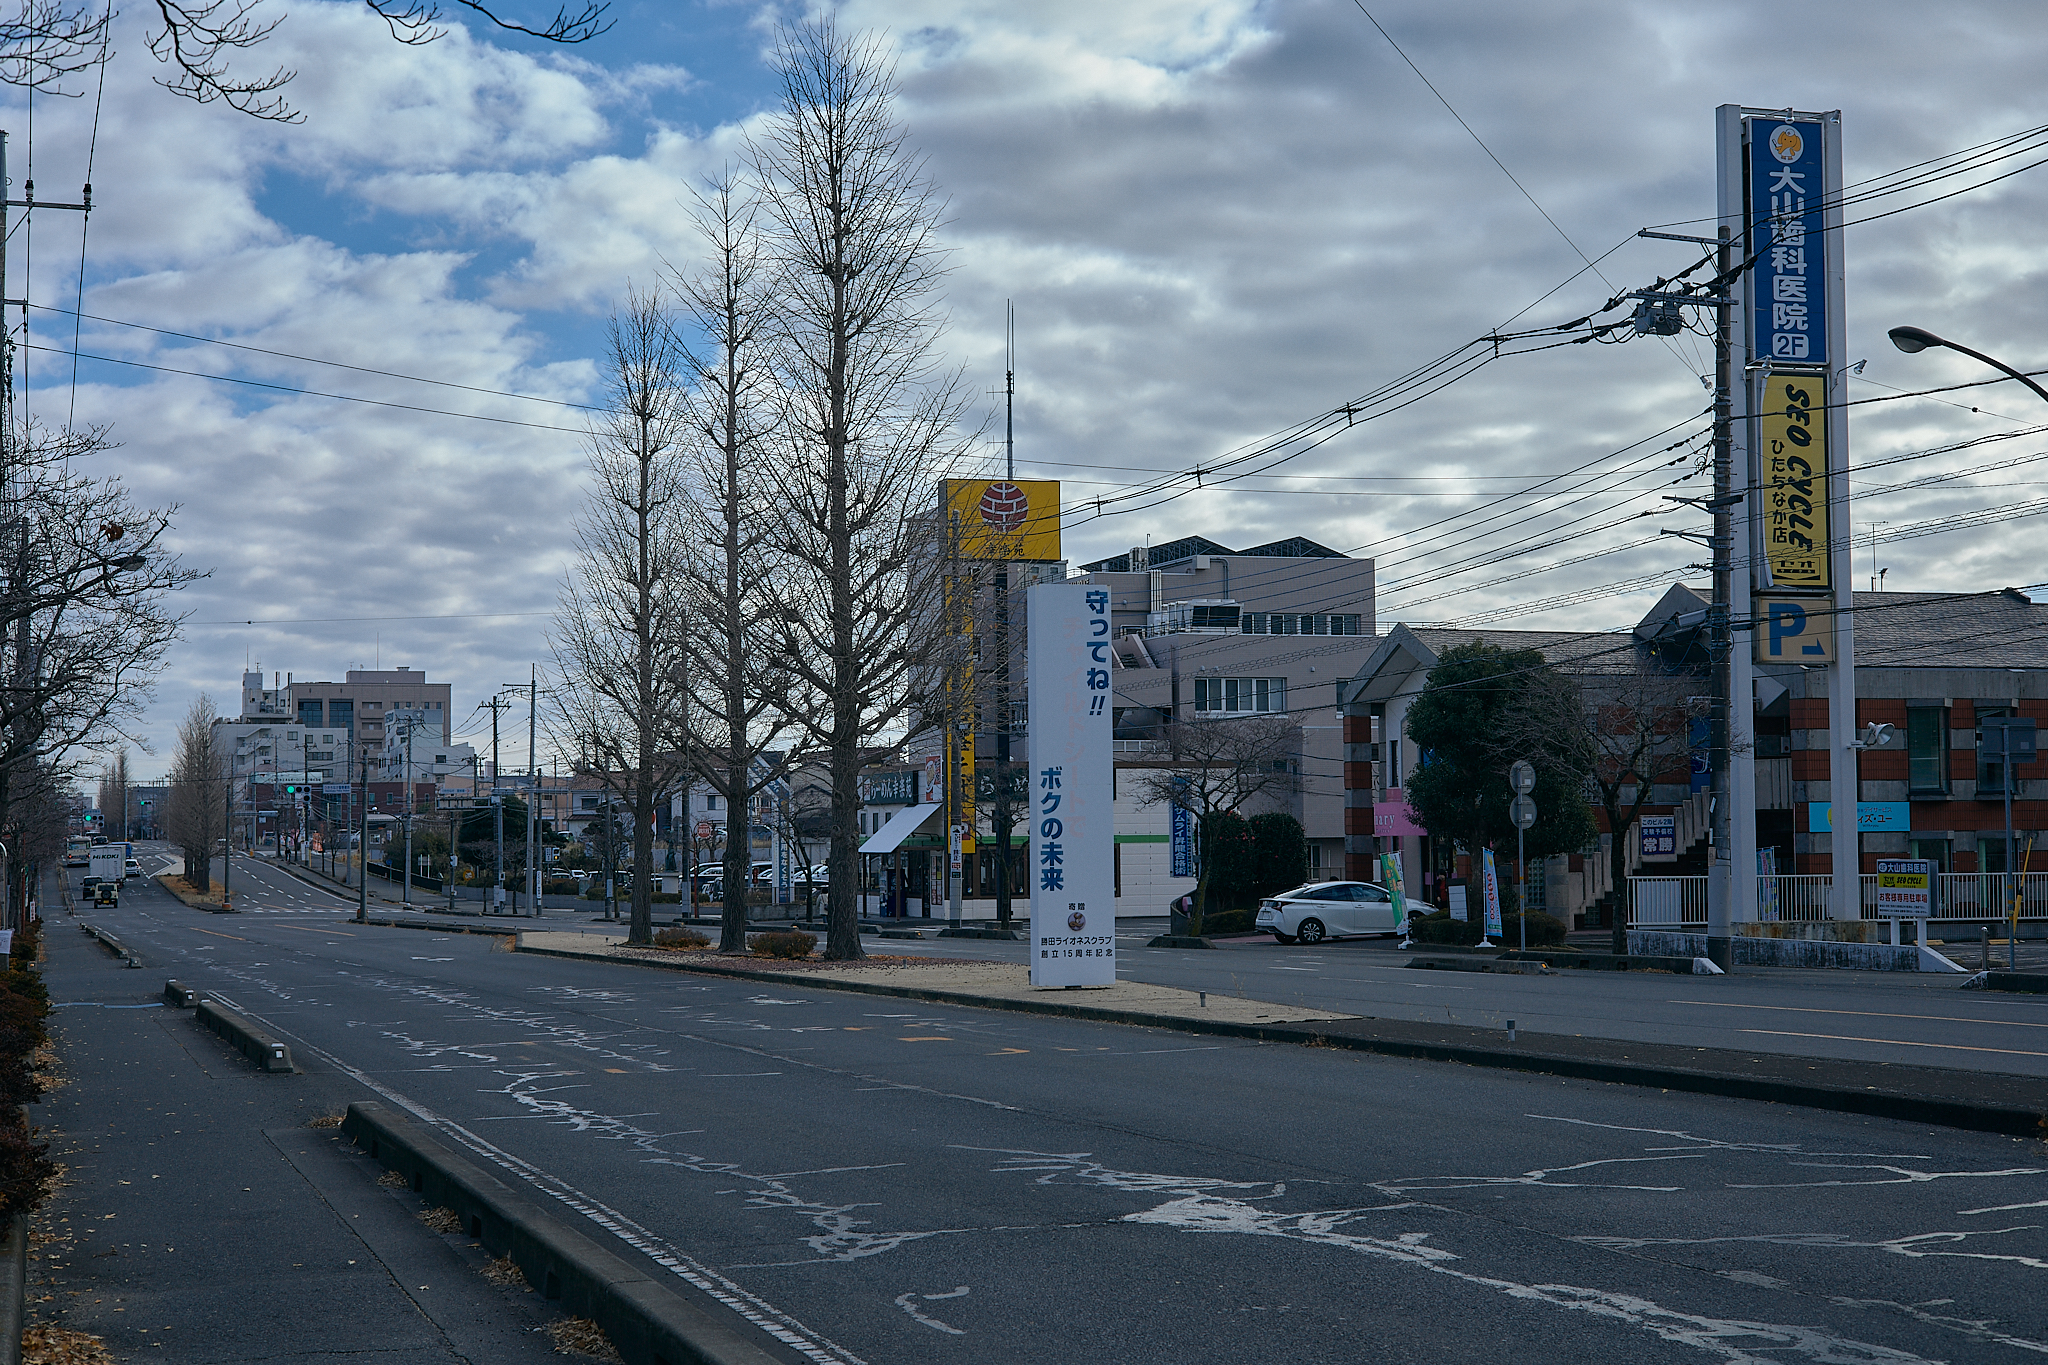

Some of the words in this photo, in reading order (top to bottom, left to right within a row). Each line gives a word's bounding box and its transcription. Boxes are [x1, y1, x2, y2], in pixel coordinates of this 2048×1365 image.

[1769, 165, 1808, 330] 大山歯科医院
[1777, 336, 1804, 356] 2F
[1786, 384, 1811, 447] SEO
[1771, 439, 1788, 544] ひたちなか店
[1787, 455, 1814, 553] CYCLE
[1768, 602, 1806, 656] P
[1040, 765, 1064, 892] ボクの未来
[1642, 818, 1673, 826] このビル2階
[1643, 837, 1673, 853] 常勝
[1887, 862, 1927, 873] 大山歯科医院
[1896, 876, 1907, 884] SEO
[1907, 876, 1922, 885] CYCLE
[1879, 892, 1928, 904] お客様専用駐車場
[1041, 935, 1112, 946] 勝田ライオネスクラブ
